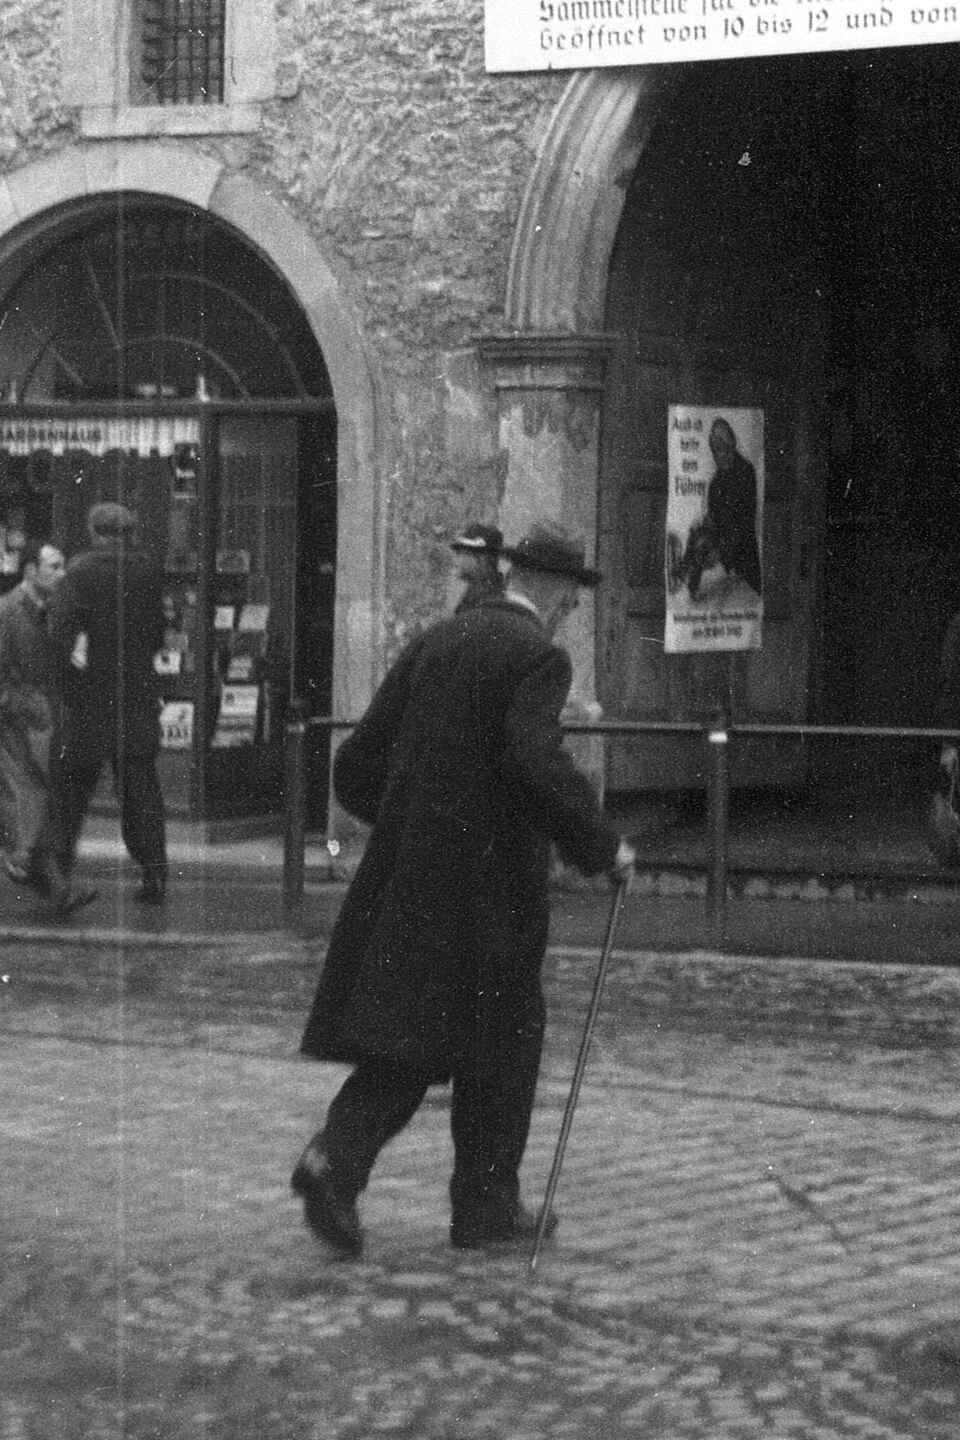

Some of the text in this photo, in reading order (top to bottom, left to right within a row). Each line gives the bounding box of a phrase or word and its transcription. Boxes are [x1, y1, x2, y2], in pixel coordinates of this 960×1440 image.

[539, 23, 645, 51] Geöffnet
[663, 26, 707, 43] von
[722, 16, 746, 38] 10
[756, 17, 793, 35] bis
[807, 9, 829, 34] 12
[846, 8, 893, 29] und
[908, 6, 958, 26] von
